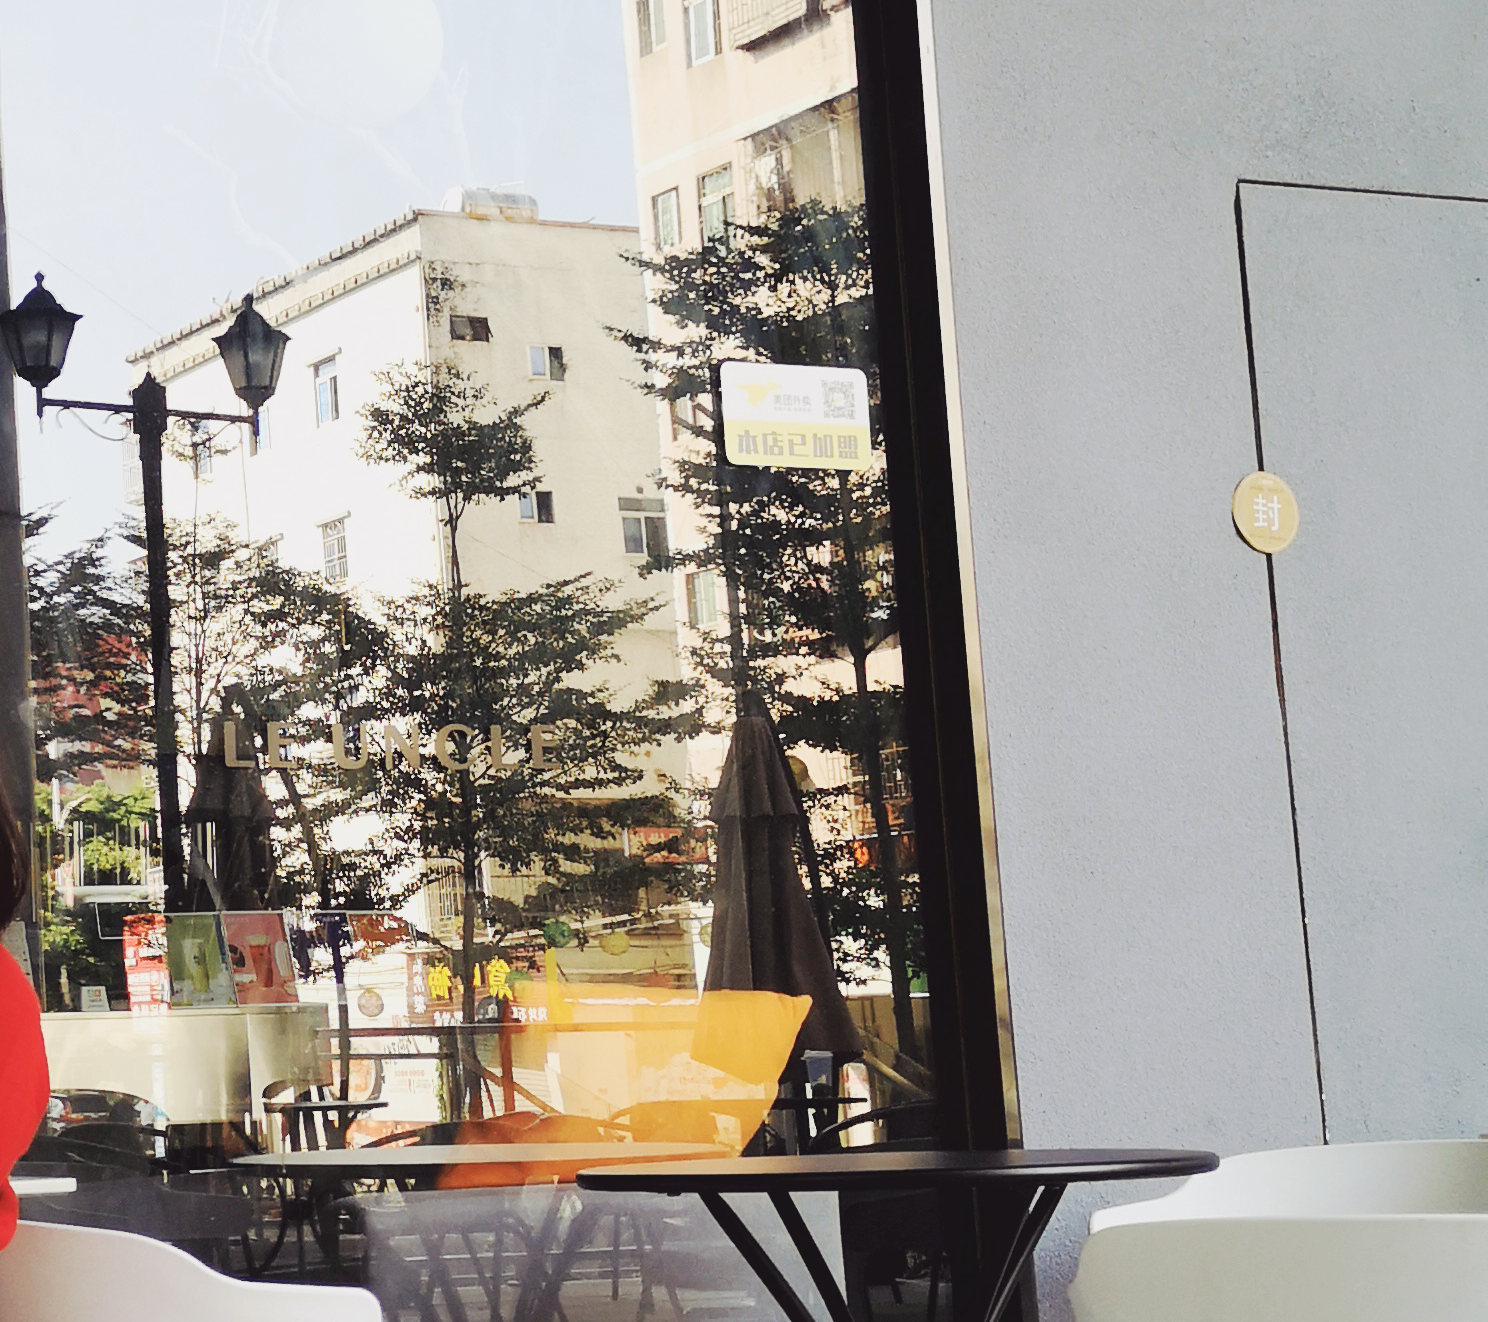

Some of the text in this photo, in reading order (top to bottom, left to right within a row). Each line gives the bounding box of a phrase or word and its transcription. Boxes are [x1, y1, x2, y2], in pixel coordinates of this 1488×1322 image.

[737, 429, 859, 460] 本店已加盟
[1253, 493, 1282, 532] 封
[223, 721, 563, 771] LE UNCLE
